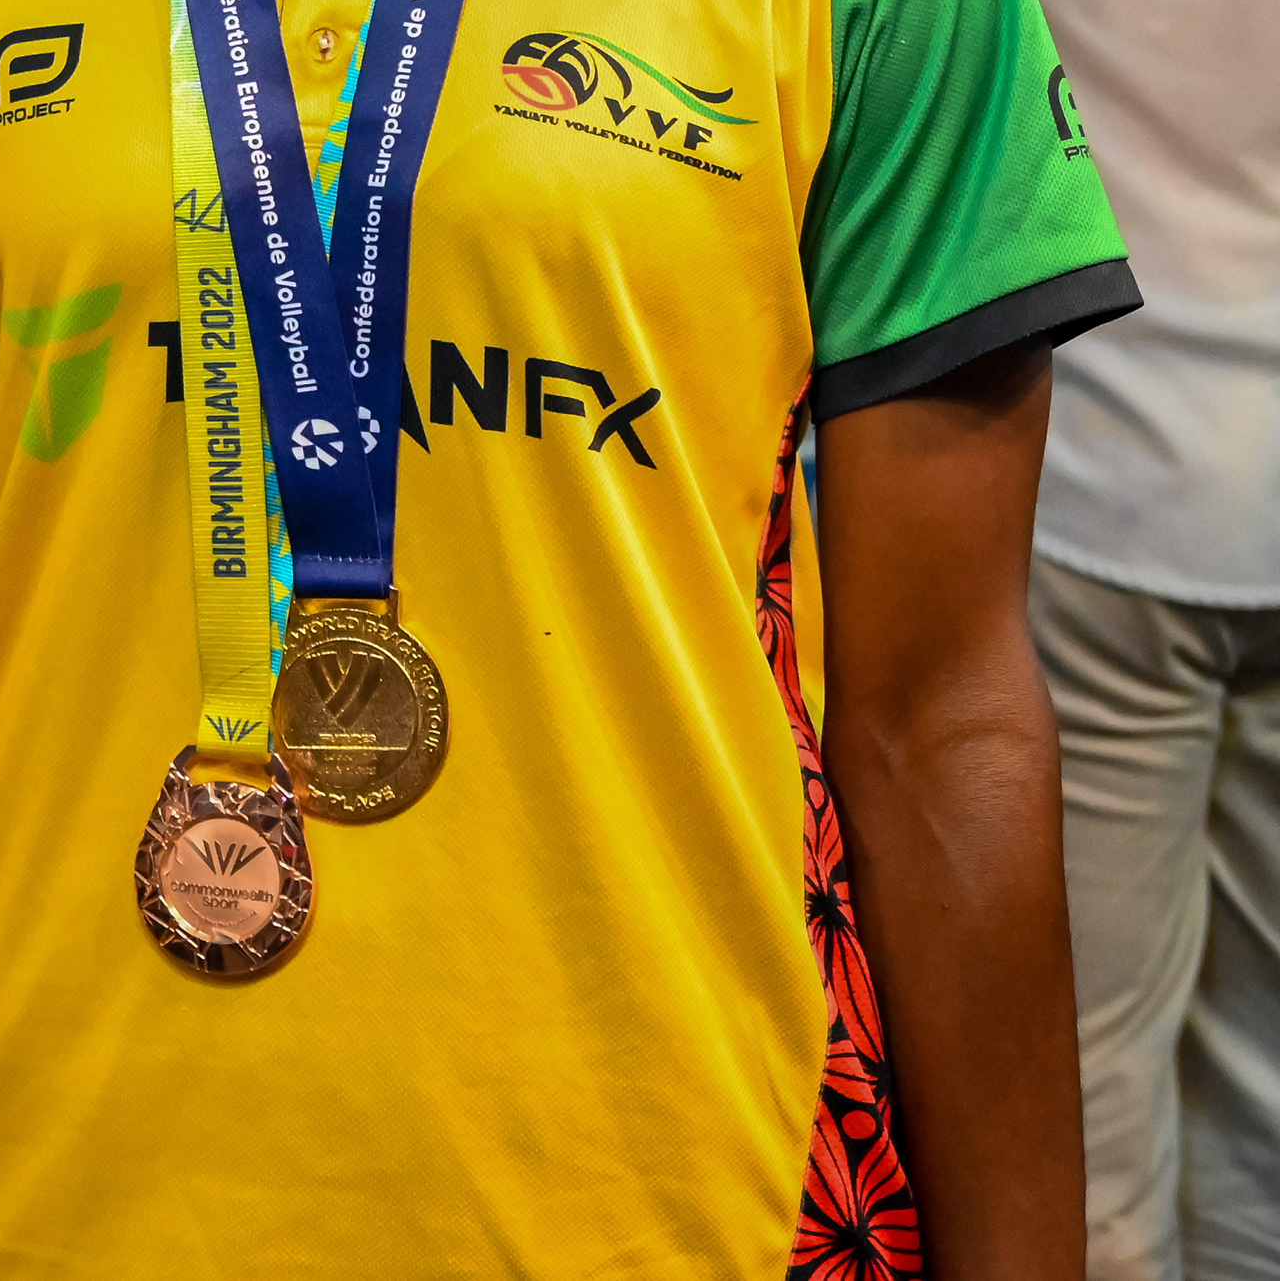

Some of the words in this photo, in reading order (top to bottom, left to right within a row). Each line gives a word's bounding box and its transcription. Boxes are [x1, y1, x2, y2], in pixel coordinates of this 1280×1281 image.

[236, 81, 279, 226] Européenne
[493, 104, 560, 126] VANUATU
[564, 119, 654, 153] VOLLEYBALL
[658, 147, 744, 182] FEDERATION
[602, 96, 713, 152] VVF
[350, 195, 384, 378] Confédération
[367, 44, 417, 188] Européenne
[402, 7, 426, 39] de
[267, 233, 289, 265] de
[197, 266, 237, 351] 2022
[274, 270, 318, 393] Volleyball
[201, 361, 248, 579] BIRMINGHAM
[170, 880, 275, 904] commonwealth
[202, 896, 240, 911] sport
